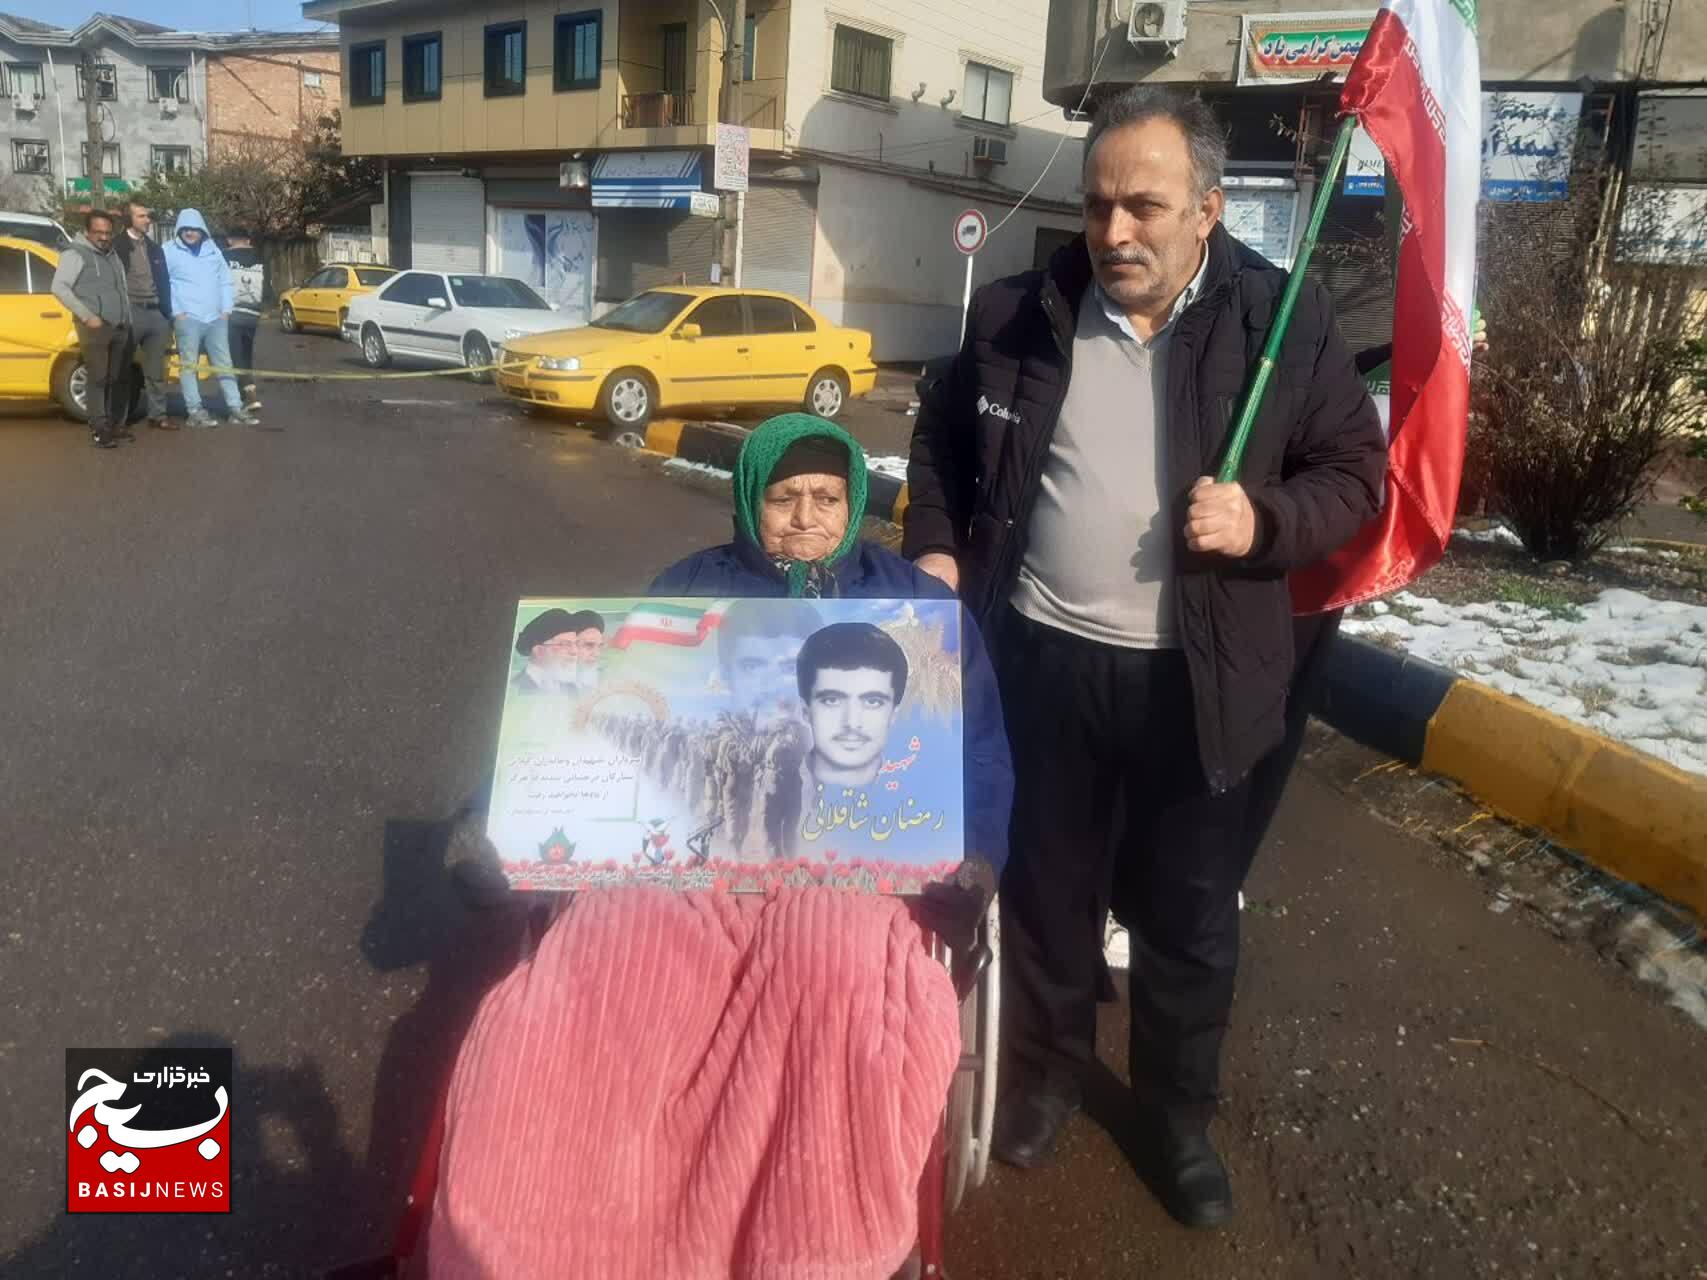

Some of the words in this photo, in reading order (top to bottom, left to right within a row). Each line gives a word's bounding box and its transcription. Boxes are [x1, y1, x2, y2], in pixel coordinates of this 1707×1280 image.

[879, 735, 921, 790] شهید
[801, 783, 869, 841] شاقلانی
[870, 798, 945, 841] رمضان
